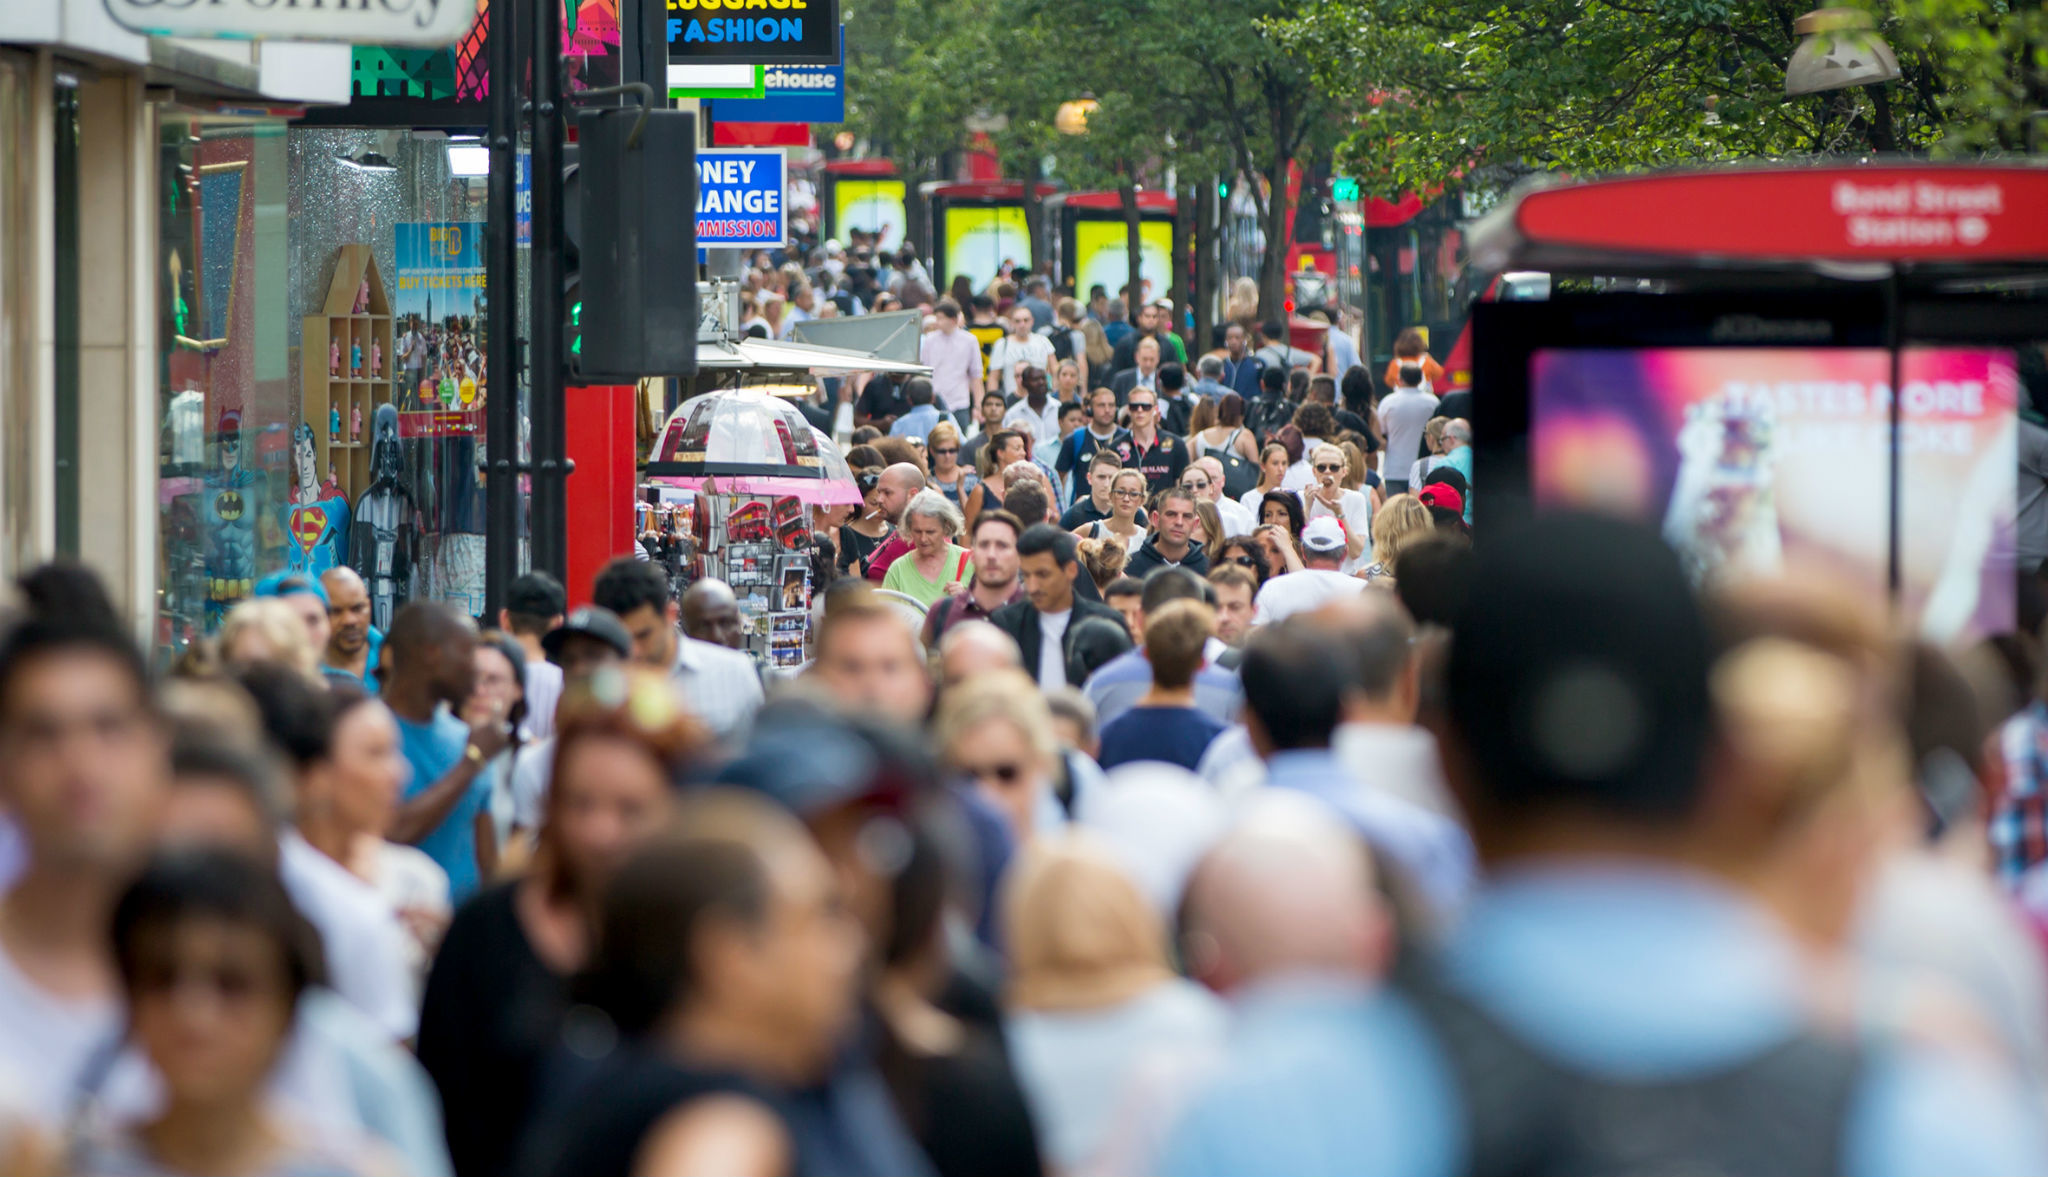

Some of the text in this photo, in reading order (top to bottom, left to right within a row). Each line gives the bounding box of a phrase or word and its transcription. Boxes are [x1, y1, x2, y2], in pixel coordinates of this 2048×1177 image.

[666, 17, 803, 43] FASHION
[1832, 181, 2003, 215] Bond Street
[1848, 215, 1954, 245] Station
[399, 274, 487, 289] BUY TICKETS HERE
